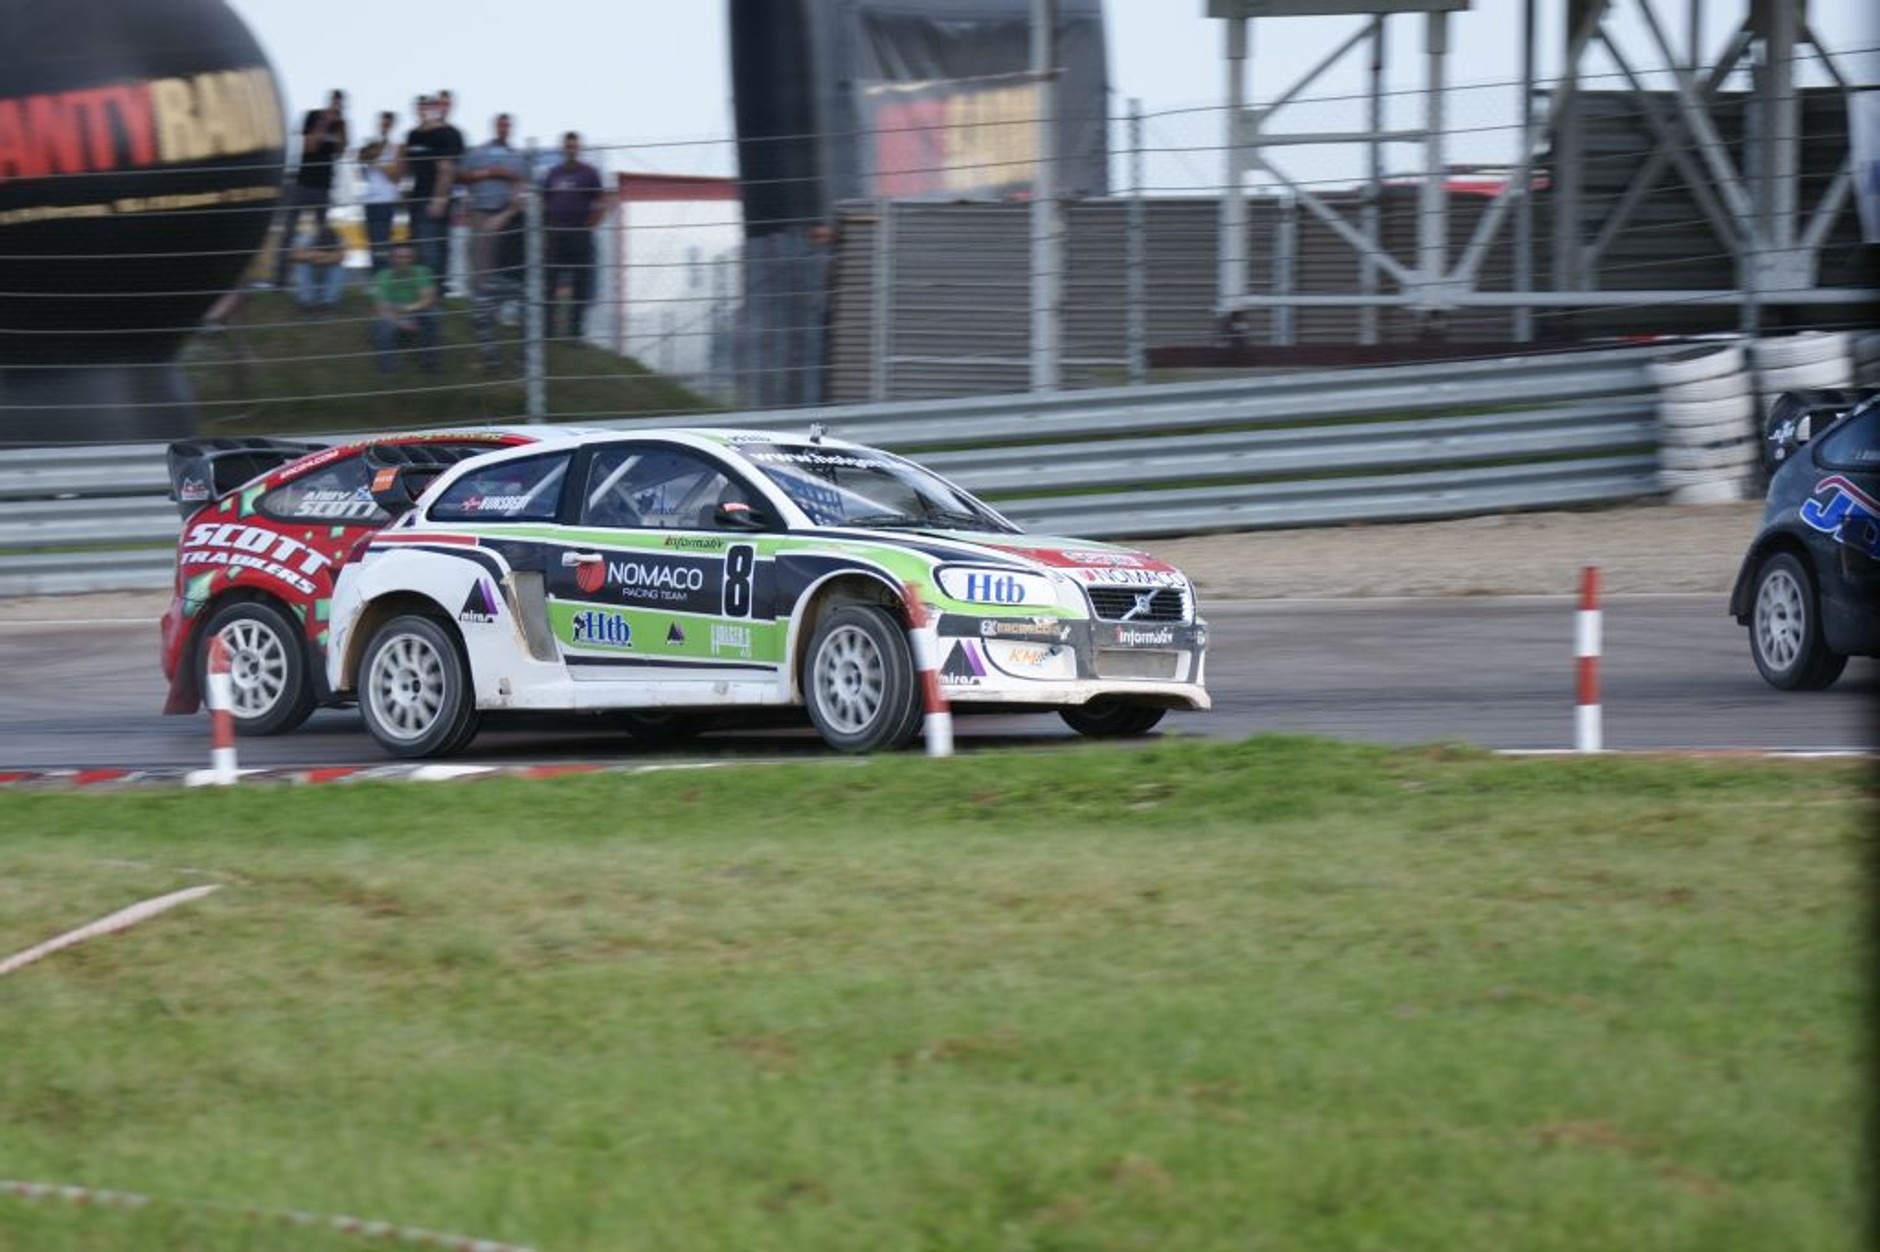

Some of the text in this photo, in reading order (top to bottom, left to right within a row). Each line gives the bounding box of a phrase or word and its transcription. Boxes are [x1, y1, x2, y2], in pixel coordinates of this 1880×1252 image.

[294, 501, 378, 517] SCOTT
[184, 523, 332, 575] SCOTT
[607, 561, 703, 591] NOMACO
[725, 544, 754, 616] 8
[967, 573, 1025, 604] Htb
[1094, 569, 1185, 587] NOMACO
[622, 587, 688, 601] RACING TEAM
[586, 611, 631, 642] Htb
